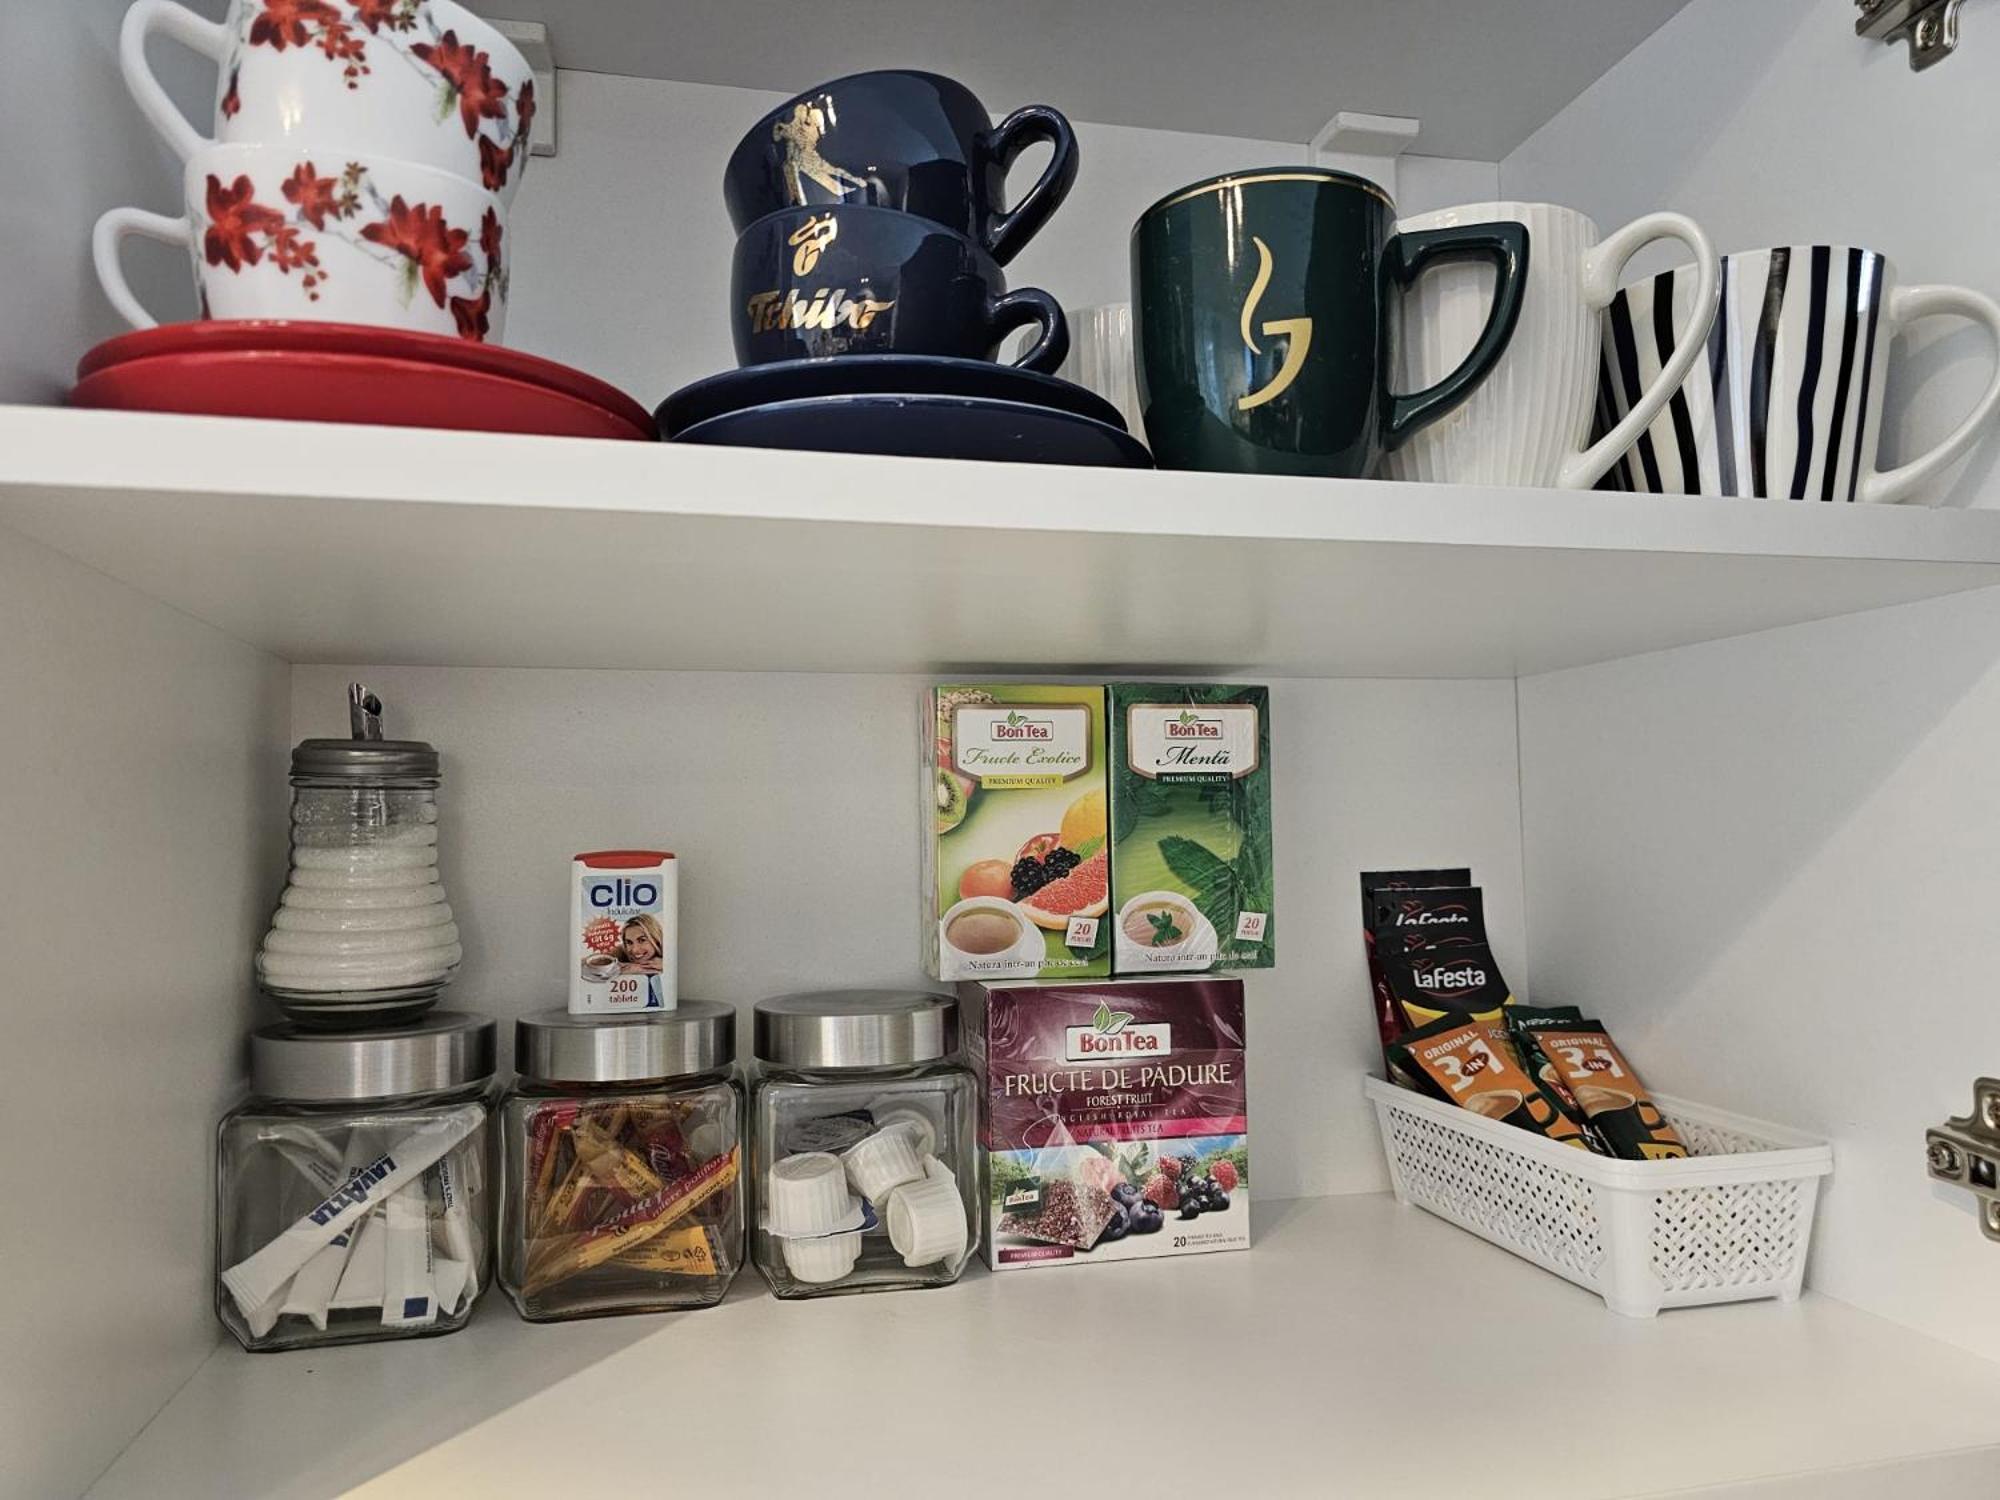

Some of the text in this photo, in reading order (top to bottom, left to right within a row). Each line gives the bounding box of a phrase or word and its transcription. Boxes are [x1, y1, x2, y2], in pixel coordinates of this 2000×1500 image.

[748, 288, 895, 333] Tchibo
[962, 747, 1020, 765] Fructe
[989, 777, 1057, 785] PREMIUM QUALITY
[590, 878, 657, 907] clio
[1074, 923, 1091, 935] 20
[1244, 917, 1260, 929] 20
[610, 980, 638, 992] 200
[1413, 967, 1486, 989] LaFesta
[1424, 1030, 1479, 1060] ORIGINAL
[1550, 1037, 1607, 1048] ORIGINAL
[1557, 1047, 1594, 1078] 3
[1005, 1070, 1094, 1097] FRUCTE
[1102, 1068, 1133, 1091] DE
[1433, 1055, 1475, 1093] 3
[1087, 1093, 1152, 1107] FOREST FRUIT
[1147, 1123, 1164, 1133] TEA
[309, 1156, 397, 1226] LAVAZZA
[1173, 1236, 1186, 1247] 20
